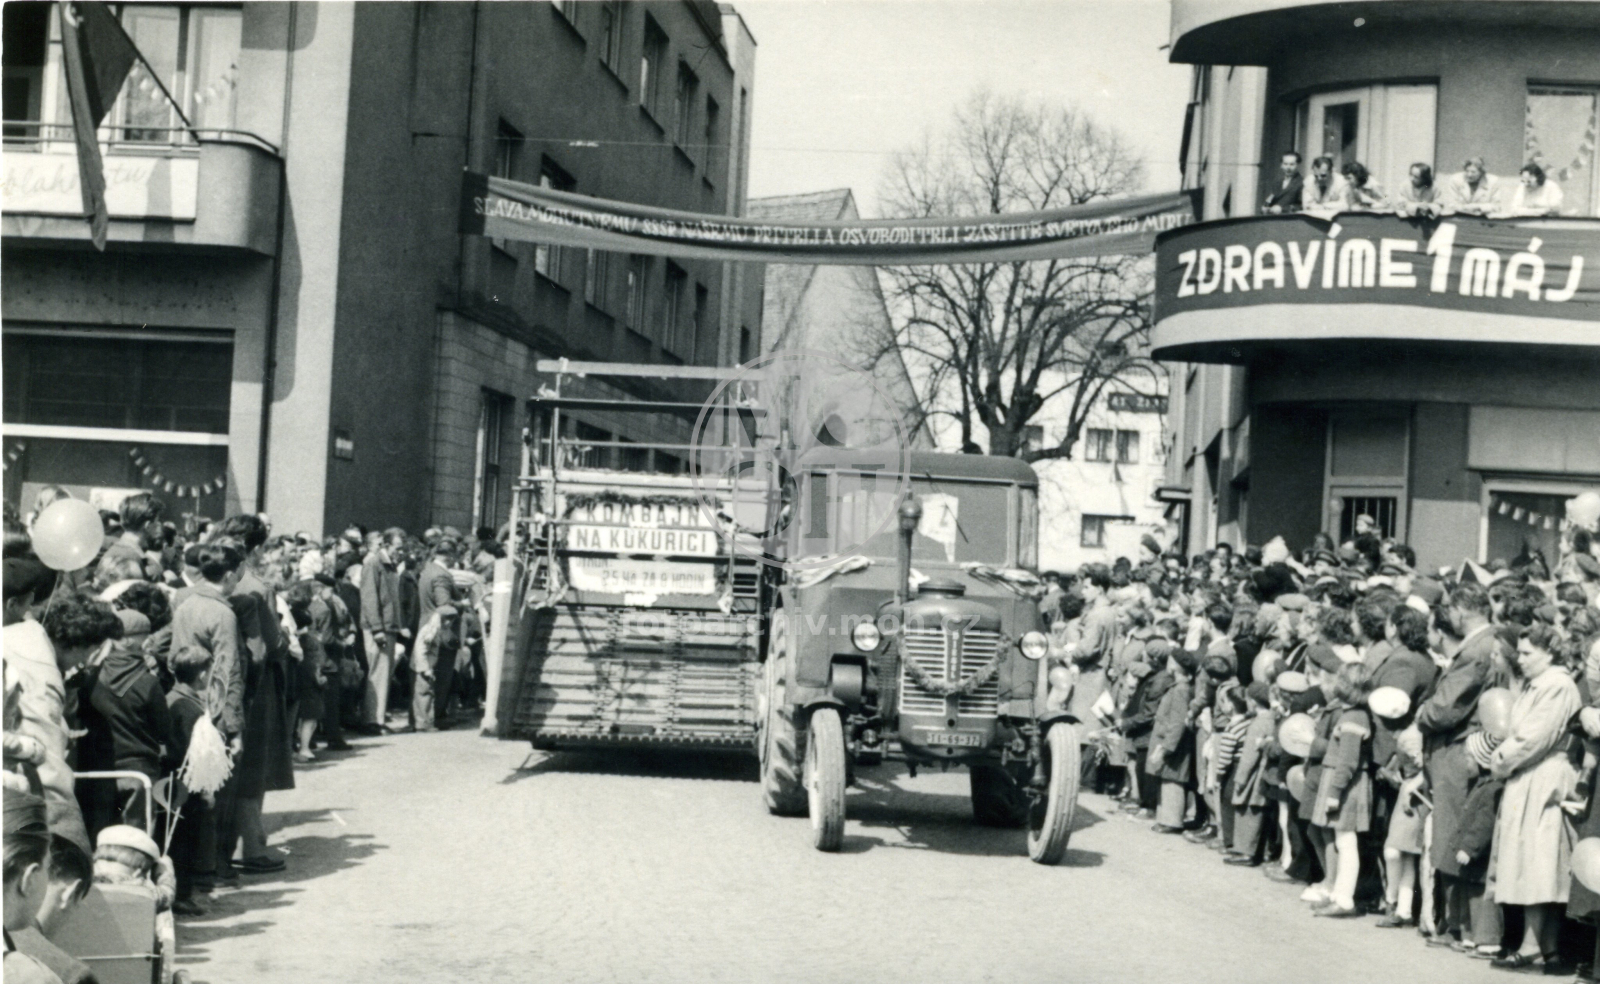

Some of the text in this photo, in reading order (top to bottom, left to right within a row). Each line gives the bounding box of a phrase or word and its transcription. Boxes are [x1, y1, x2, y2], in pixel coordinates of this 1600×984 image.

[822, 228, 835, 244] A
[1178, 222, 1418, 298] ZDRAVÍME
[1427, 223, 1457, 293] 1
[586, 501, 699, 527] KOMBAJN
[576, 528, 602, 549] NA
